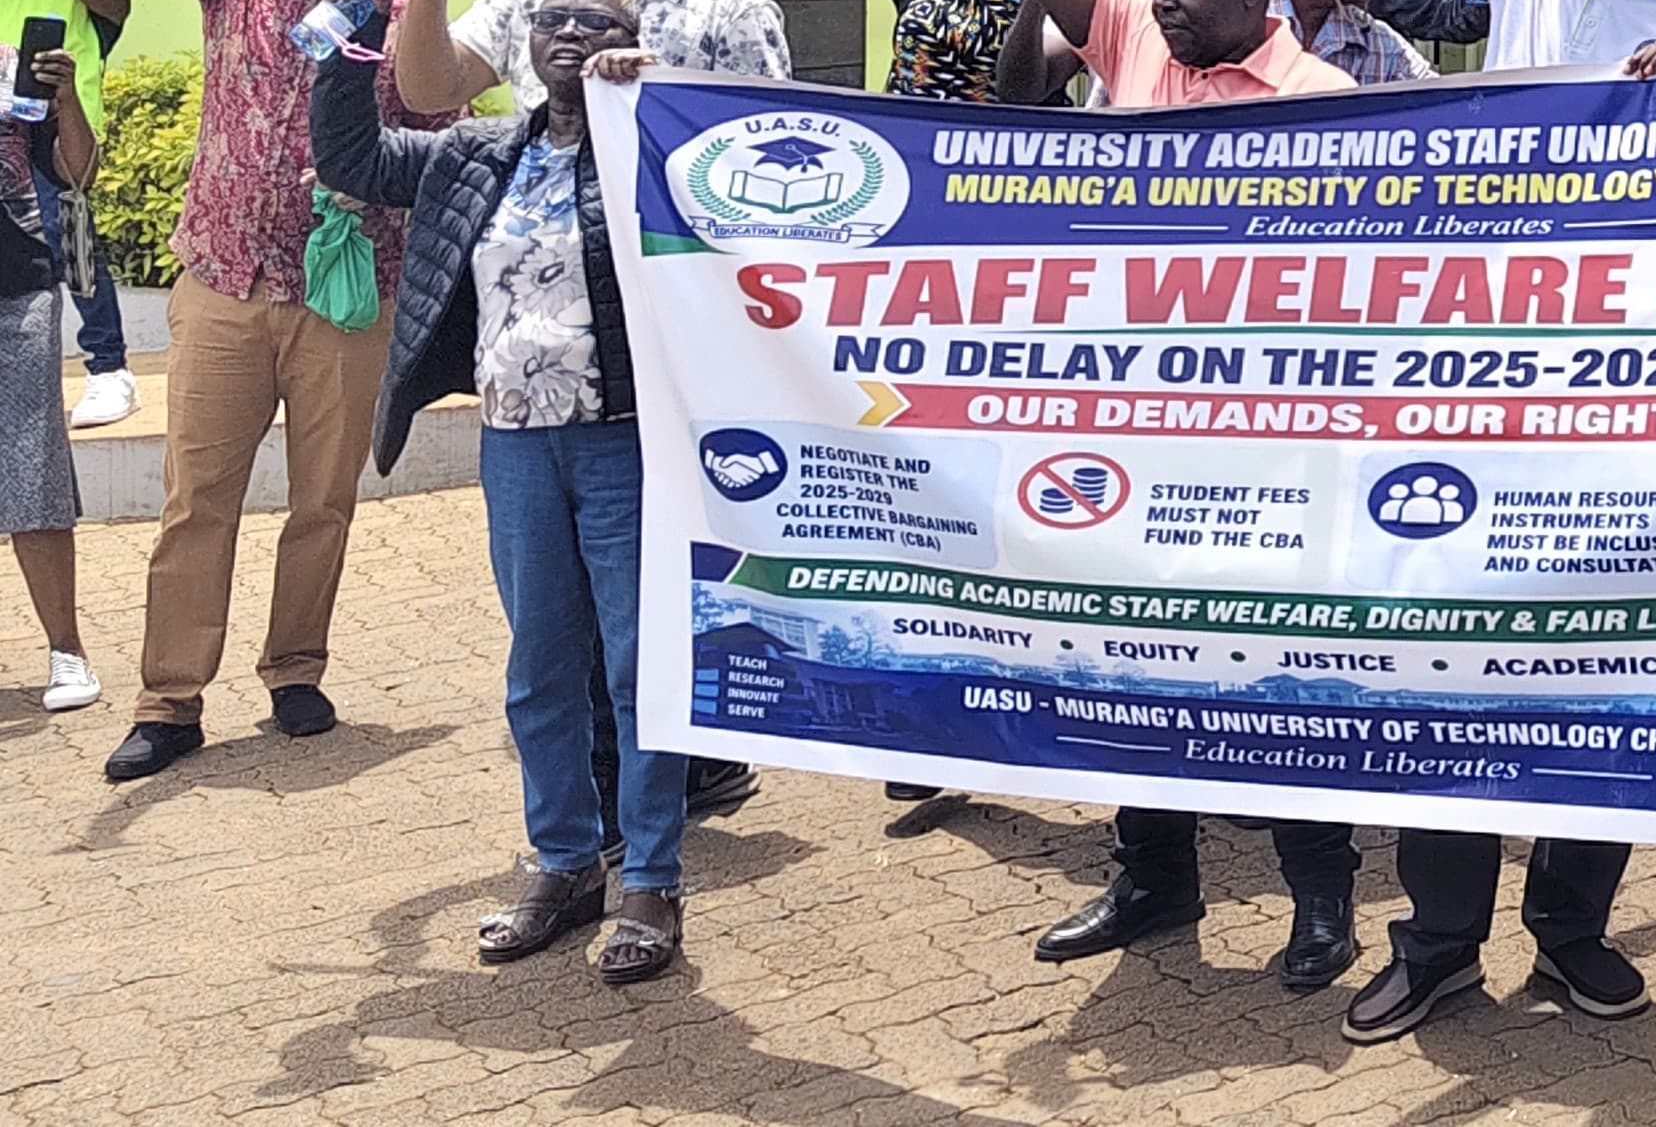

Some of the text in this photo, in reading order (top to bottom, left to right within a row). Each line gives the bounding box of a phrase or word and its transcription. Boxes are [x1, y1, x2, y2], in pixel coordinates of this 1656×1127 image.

[745, 118, 840, 137] U.A.S.U.
[933, 129, 1200, 169] UNIVERSITY
[1204, 128, 1415, 169] ACADEMIC
[1426, 126, 1540, 168] STAFF
[1147, 175, 1366, 207] UNIVERSITY
[1375, 175, 1425, 207] OF
[714, 226, 842, 242] EDUCATION LIBERATES
[1245, 215, 1554, 237] Education Liberates
[736, 258, 1097, 331] STAFF
[1124, 253, 1634, 325] WELFARE
[834, 335, 926, 376] NO
[945, 339, 1143, 383] DELAY
[1157, 345, 1244, 384] ON
[1262, 347, 1378, 387] THE
[967, 394, 1080, 428] OUR
[1095, 398, 1378, 438] DEMANDS,
[1395, 402, 1506, 436] OUR
[800, 444, 930, 474] NEGOTIATE AND
[800, 465, 919, 492] REGISTER THE
[800, 484, 893, 506] 2025-2029
[1151, 484, 1310, 504] STUDENT FEES
[1493, 491, 1572, 507] HUMAN
[776, 503, 978, 536] COLLECTIVE BARGAINING
[1147, 507, 1261, 525] MUST NOT
[1491, 513, 1650, 529] INSTRUMENTS
[782, 524, 942, 552] AGREEMENT (CBA)
[1144, 528, 1304, 549] FUND THE CBA
[1487, 535, 1547, 551] MUST
[1553, 535, 1580, 551] BE
[1484, 557, 1529, 572] AND
[787, 567, 954, 599] DEFENDING
[959, 581, 1101, 615] ACADEMIC
[1109, 596, 1200, 621] STAFF
[1206, 600, 1358, 632] WELFARE,
[1365, 605, 1504, 632] DIGNITY
[1510, 610, 1536, 633] &
[1546, 609, 1627, 633] FAIR
[893, 618, 1033, 648] SOLIDARITY
[1104, 640, 1200, 663] EQUITY
[1277, 650, 1397, 673] JUSTICE
[728, 654, 767, 671] TEACH
[728, 671, 784, 689] RESEARCH
[728, 687, 779, 704] INNOVATE
[728, 703, 765, 719] SERVE
[963, 685, 1032, 713] UASU
[1201, 710, 1372, 742] UNIVERSITY
[1382, 720, 1420, 743] OF
[1428, 721, 1624, 752] TECHNOLOGY
[1184, 738, 1520, 780] Education Liberates
